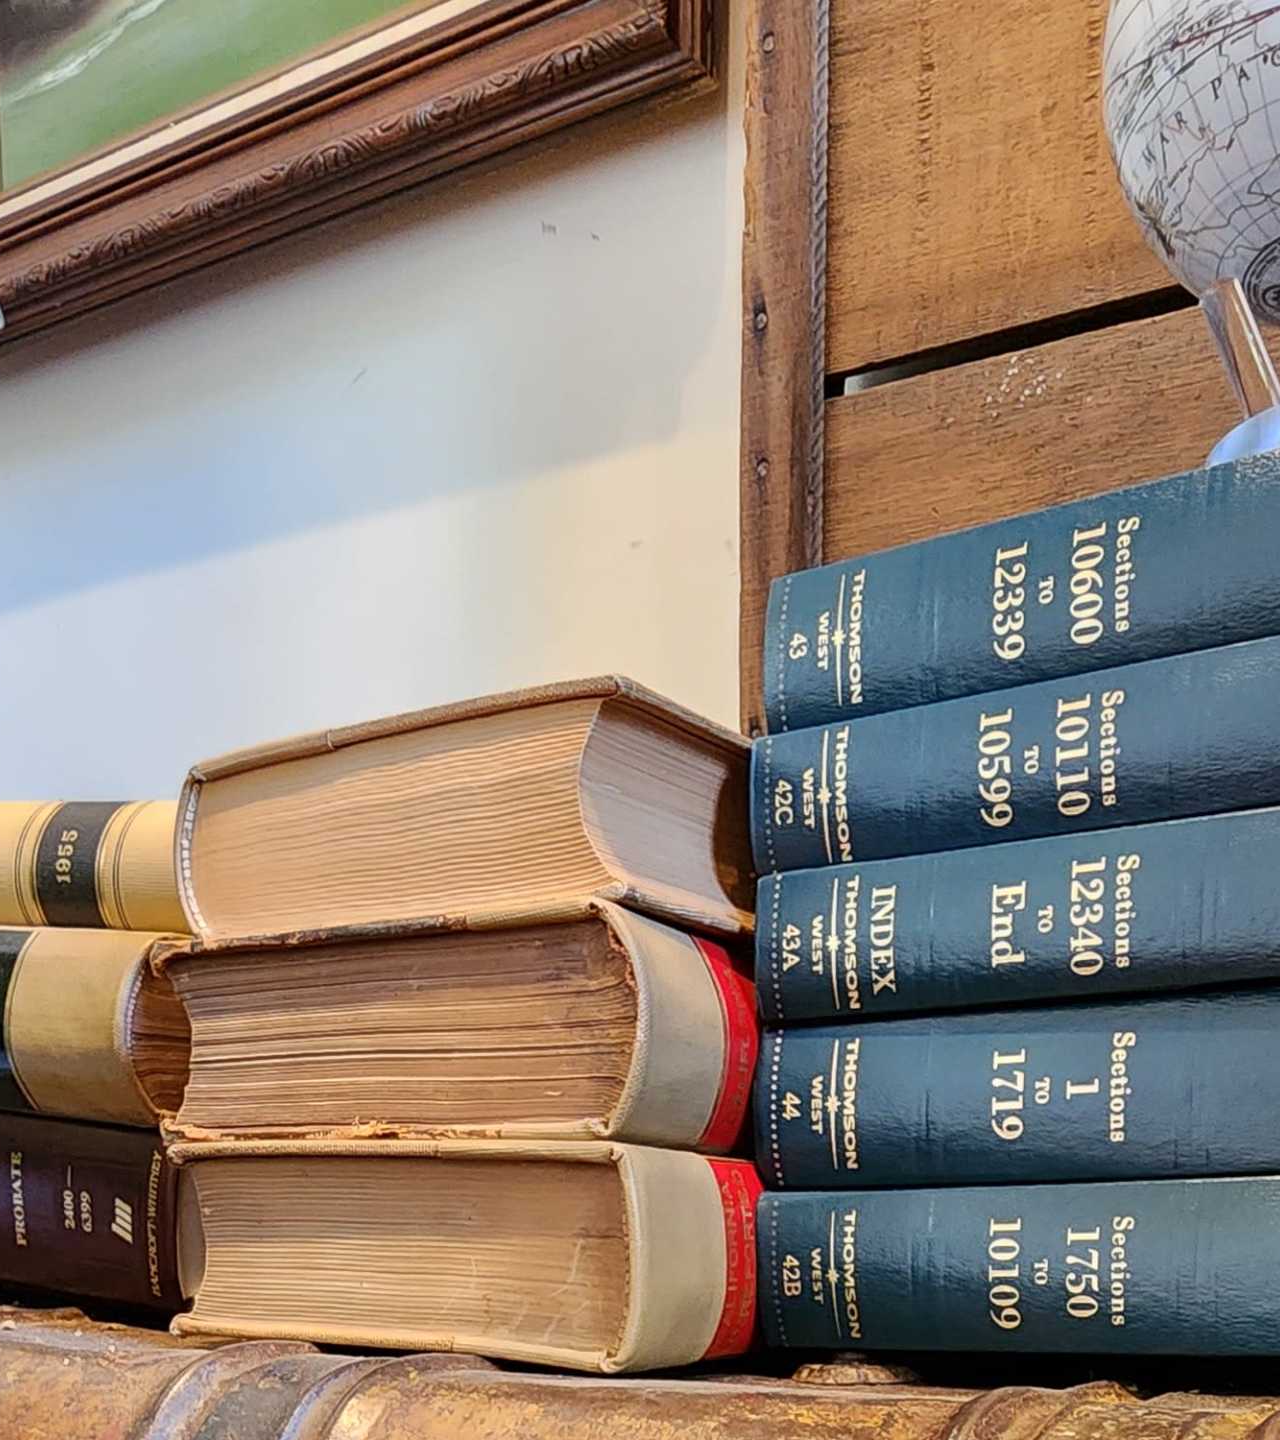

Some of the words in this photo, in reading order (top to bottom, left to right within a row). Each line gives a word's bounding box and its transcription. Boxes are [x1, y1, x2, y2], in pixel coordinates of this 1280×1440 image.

[991, 541, 1029, 662] 12339
[1038, 576, 1055, 605] TO
[1069, 521, 1107, 646] 10600
[1113, 516, 1141, 633] Sections
[788, 632, 808, 659] 43
[817, 612, 831, 671] WEST
[849, 568, 867, 705] THOMSON
[832, 726, 853, 863] THOMSON
[977, 708, 1013, 828] 10599
[1024, 746, 1040, 775] TO
[1055, 692, 1092, 817] 10110
[1099, 689, 1126, 807] Sections
[774, 779, 793, 826] 42C
[802, 768, 816, 829] WEST
[55, 829, 79, 885] 1955
[782, 924, 802, 972] 43A
[812, 914, 824, 974] WEST
[845, 874, 862, 1010] THOMSON
[870, 884, 898, 995] INDEX
[989, 881, 1027, 969] End
[1037, 905, 1054, 933] TO
[1067, 859, 1106, 977] 12340
[1115, 853, 1141, 970] Sections
[782, 1091, 802, 1121] 44
[812, 1075, 823, 1134] WEST
[844, 1037, 861, 1171] THOMSON
[990, 1047, 1026, 1142] 1719
[1035, 1076, 1051, 1105] TO
[1065, 1078, 1100, 1100] 1
[1109, 1030, 1137, 1143] Sections
[11, 1151, 27, 1247] PROBATE
[80, 1191, 93, 1233] 6399
[783, 1254, 802, 1297] 42B
[812, 1249, 823, 1305] WEST
[842, 1210, 861, 1339] THOMSON
[988, 1217, 1023, 1330] 10109
[1034, 1259, 1049, 1286] TO
[1064, 1226, 1101, 1319] 1750
[1111, 1215, 1136, 1327] Sections
